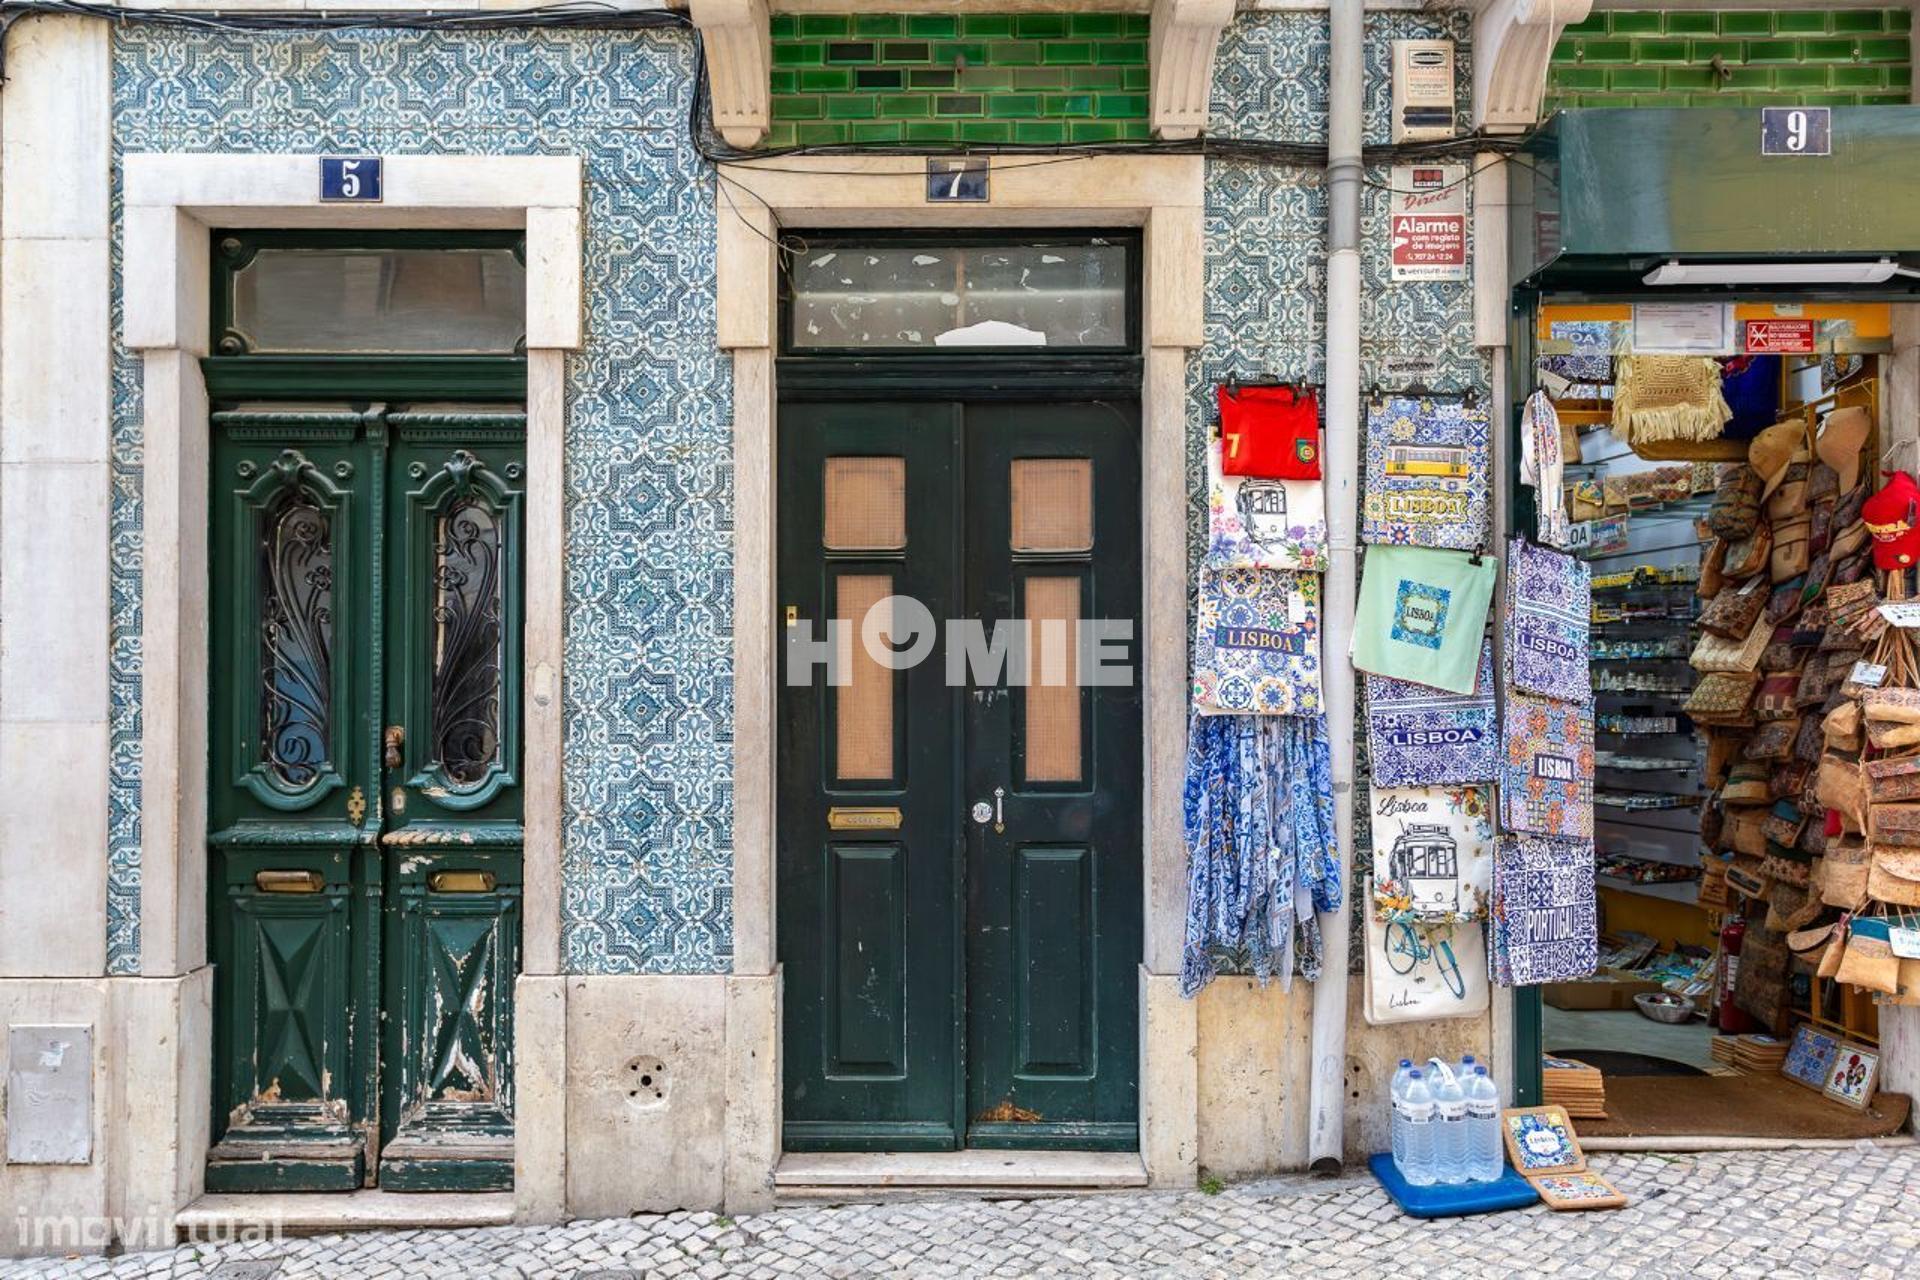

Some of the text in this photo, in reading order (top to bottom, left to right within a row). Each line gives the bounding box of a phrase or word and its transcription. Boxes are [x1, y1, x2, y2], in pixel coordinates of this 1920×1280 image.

[1786, 109, 1807, 152] 9
[341, 159, 360, 198] 5
[948, 161, 967, 198] 7
[1398, 218, 1460, 233] Alarme
[1411, 234, 1460, 244] com registo
[1412, 242, 1424, 250] de
[1226, 433, 1240, 459] 7
[1391, 499, 1457, 514] LISBOA
[1228, 629, 1294, 651] LISBOA
[1519, 633, 1575, 659] LISBOA
[1393, 730, 1477, 746] LISBOA
[1538, 757, 1572, 781] LISBOA
[1376, 795, 1429, 817] Lisboa
[1528, 908, 1575, 942] PORTUGAL
